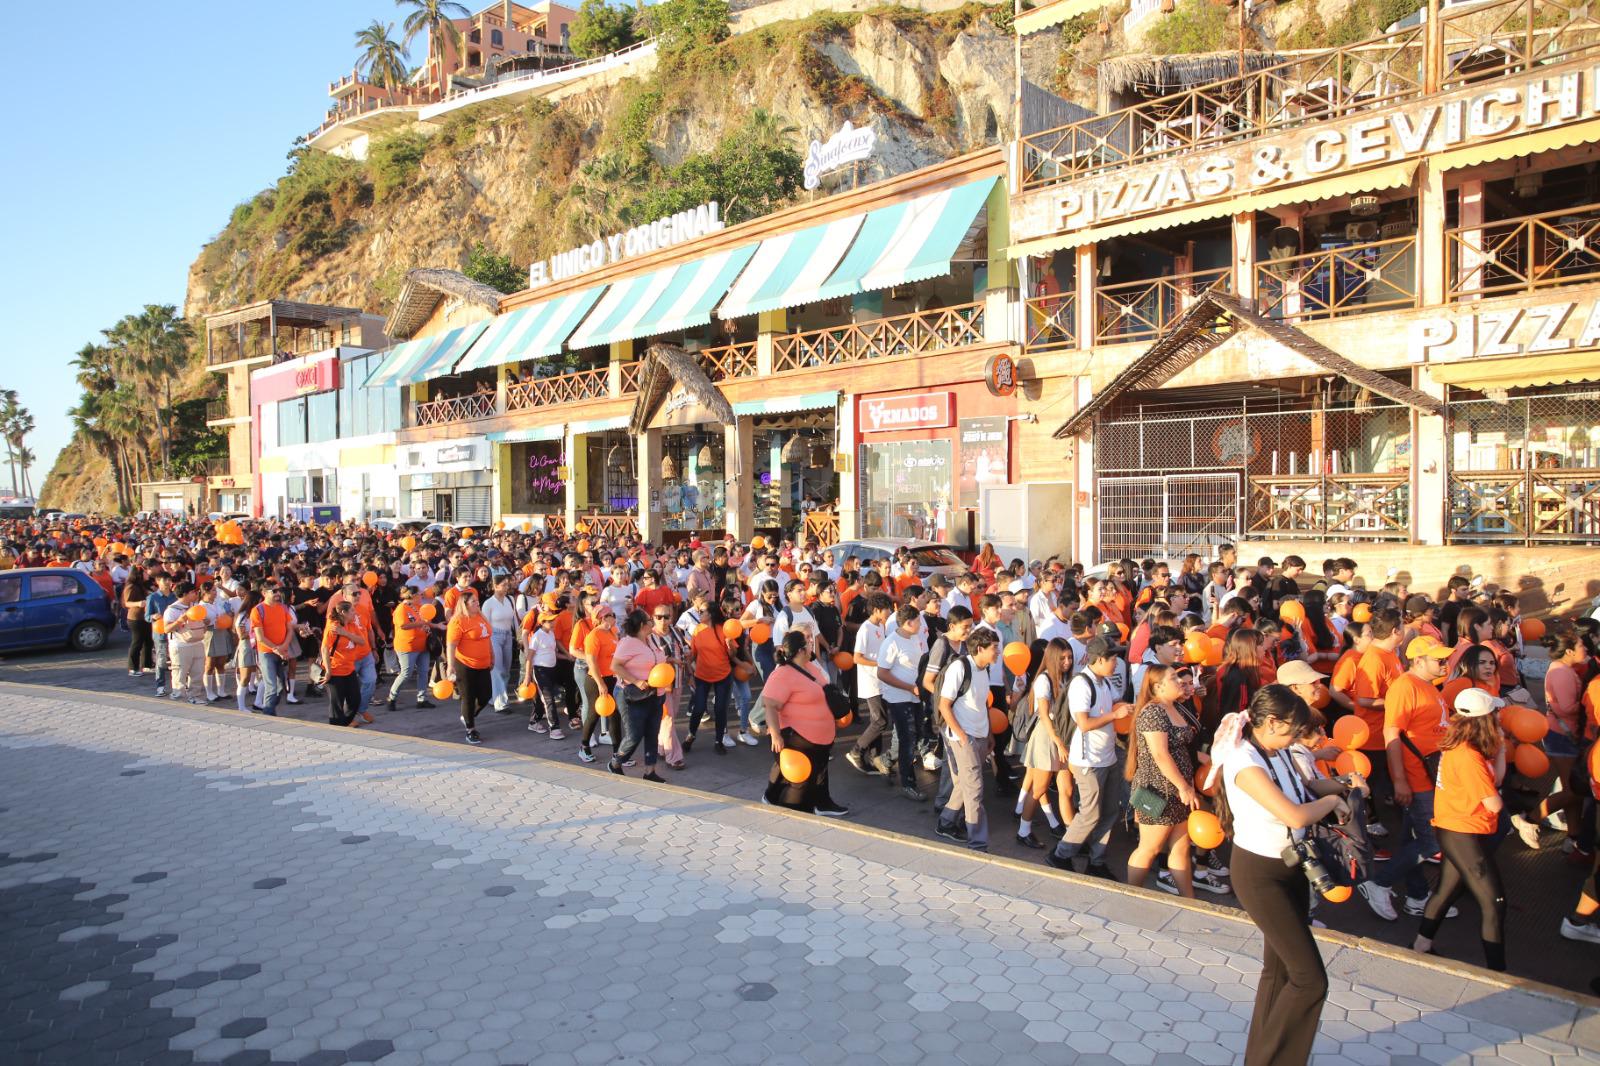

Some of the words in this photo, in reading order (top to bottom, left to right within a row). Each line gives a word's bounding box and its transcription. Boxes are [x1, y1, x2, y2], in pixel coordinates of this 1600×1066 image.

[1053, 155, 1235, 229] PIZZAS
[1252, 145, 1293, 186] &
[1304, 66, 1600, 173] CEVICH
[530, 260, 548, 288] EL
[551, 239, 605, 281] UNICO
[607, 233, 624, 263] Y
[625, 201, 725, 257] ORIGINAL
[868, 401, 938, 429] VENADOS
